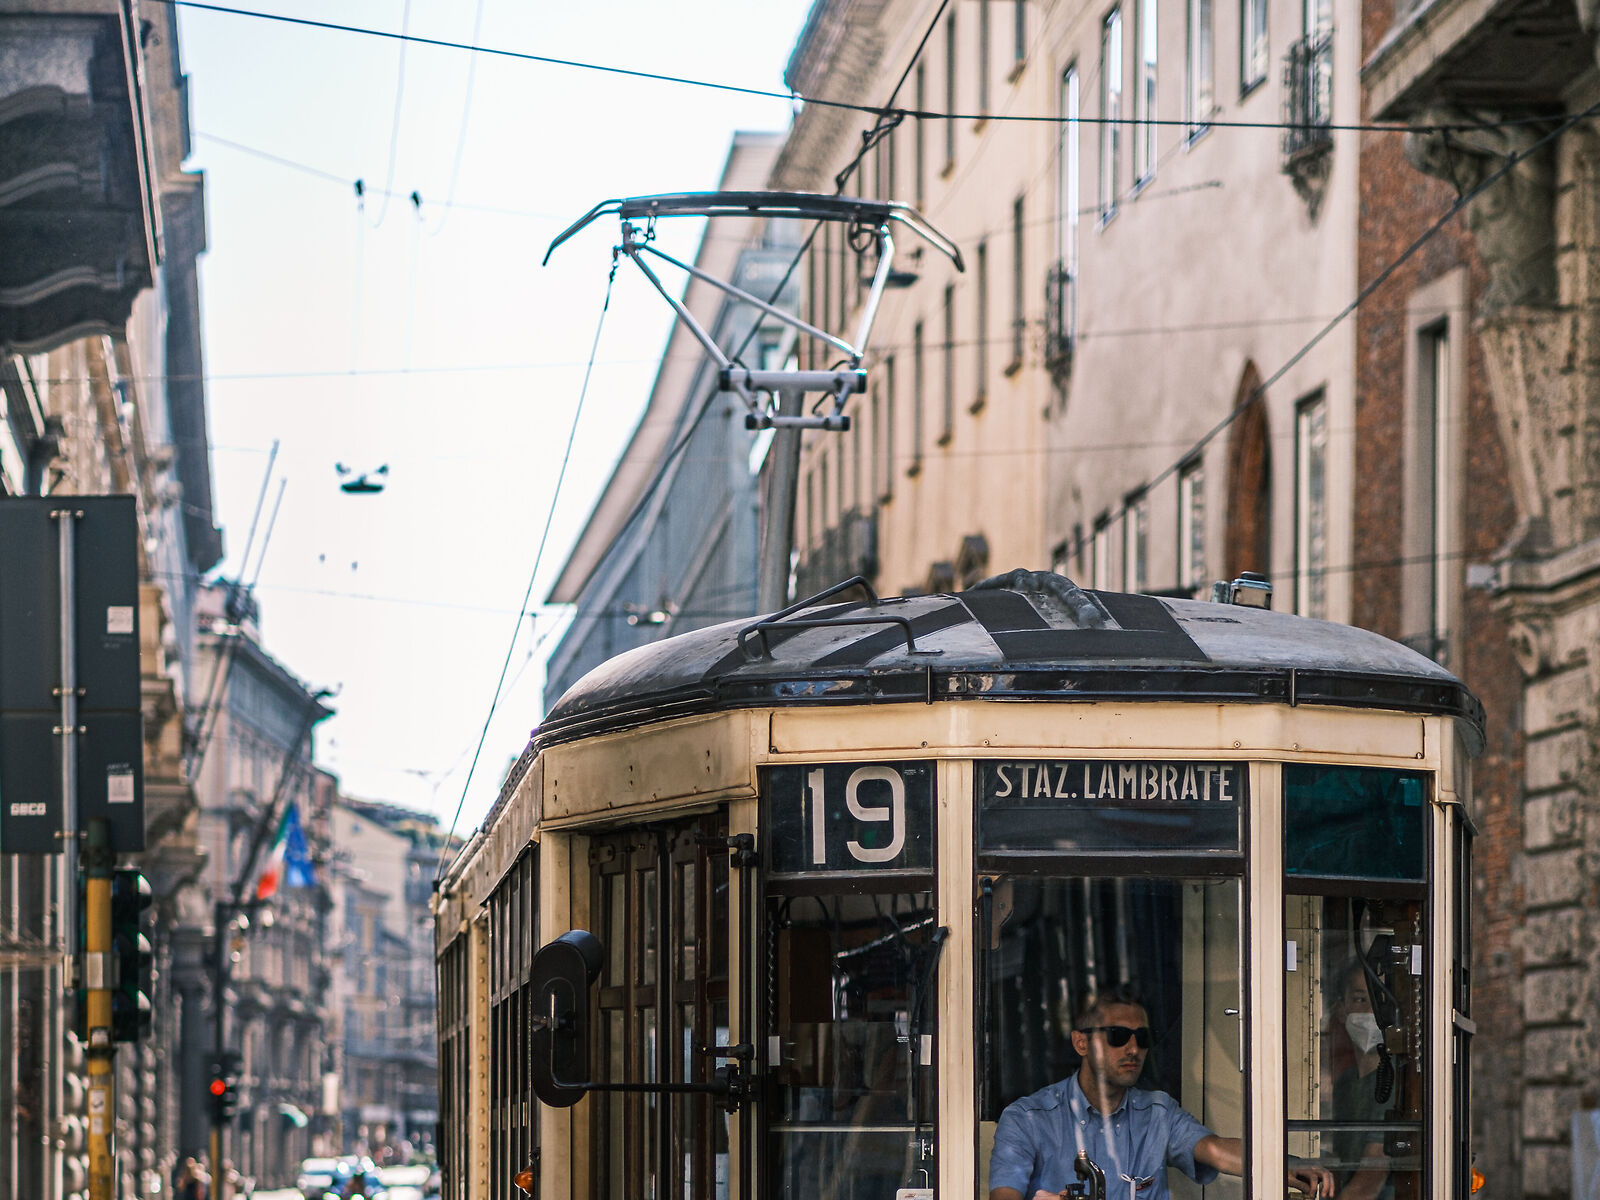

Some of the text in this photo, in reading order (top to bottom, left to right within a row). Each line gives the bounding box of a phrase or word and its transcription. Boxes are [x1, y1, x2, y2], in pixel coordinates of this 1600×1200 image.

[808, 765, 906, 865] 19
[995, 763, 1234, 801] STAZ. LAMBRATE
